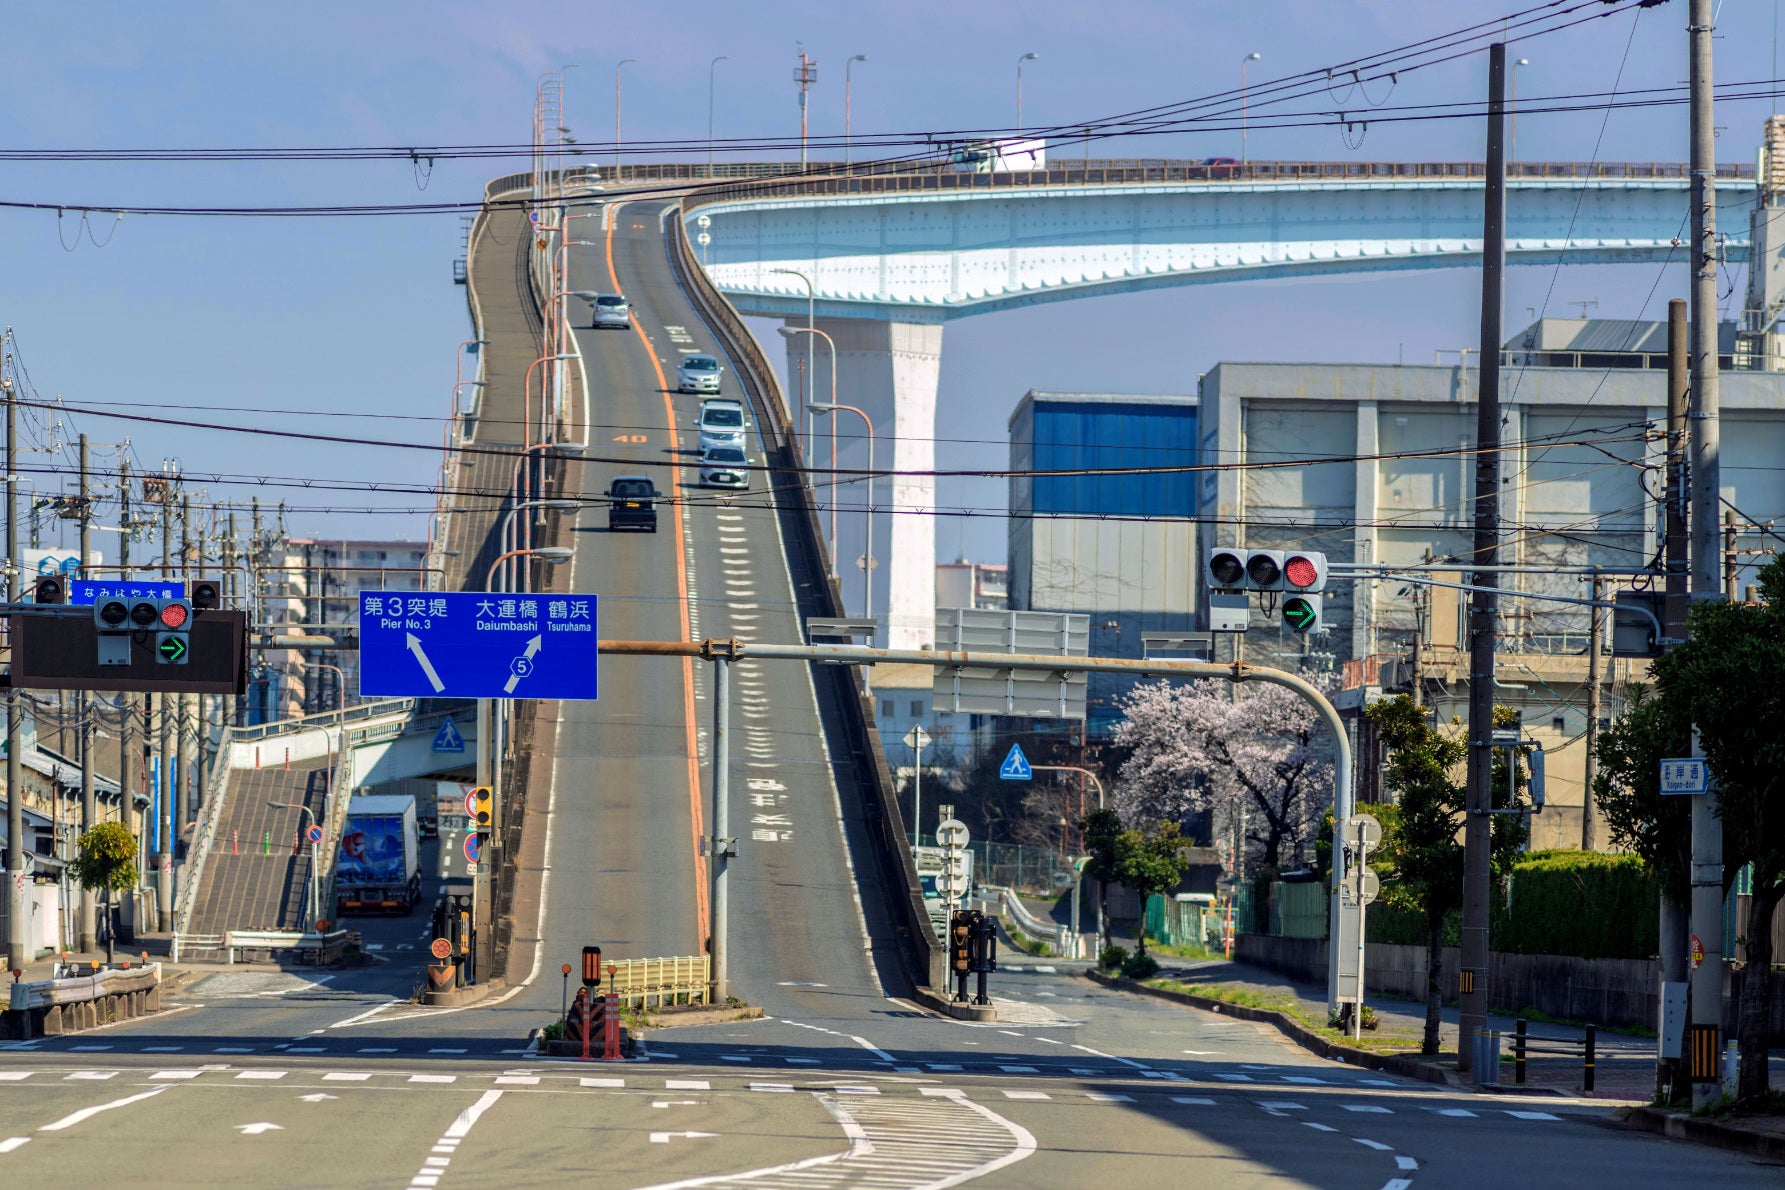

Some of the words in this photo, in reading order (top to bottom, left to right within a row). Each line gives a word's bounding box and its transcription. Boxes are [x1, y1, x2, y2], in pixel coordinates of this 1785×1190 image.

[364, 597, 448, 617] 第3突堤
[475, 599, 538, 619] 大運橋
[548, 600, 590, 619] 鶴浜
[381, 618, 402, 629] Pier
[476, 620, 538, 631] Daiumbashi
[546, 621, 591, 632] Tsuruhama
[517, 661, 527, 673] 5
